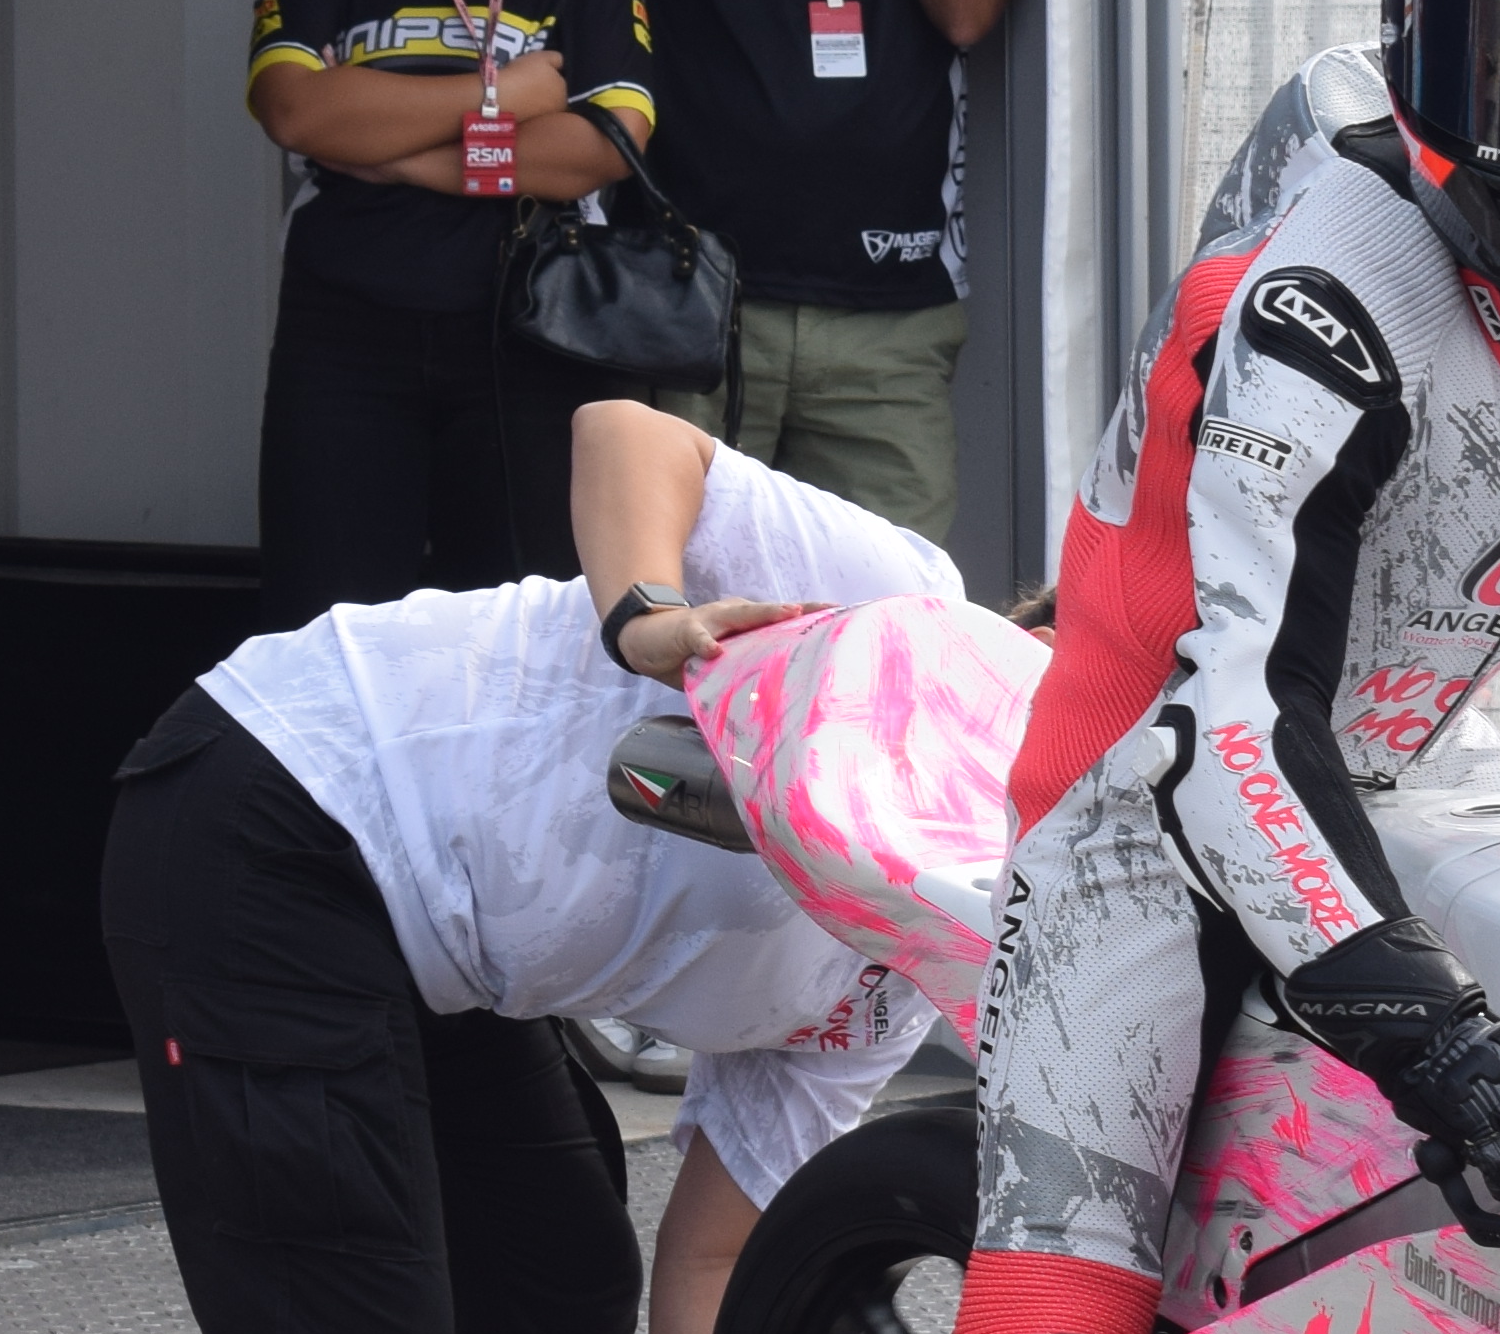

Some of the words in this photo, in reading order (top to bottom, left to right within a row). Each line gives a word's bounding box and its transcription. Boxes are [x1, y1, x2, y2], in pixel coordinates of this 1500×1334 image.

[467, 147, 512, 163] RSM
[1199, 419, 1292, 471] PIRELLI
[1354, 661, 1437, 703] NO
[1211, 723, 1269, 770] NO
[1340, 709, 1435, 752] MO
[1239, 772, 1303, 850] ONE
[1270, 843, 1359, 946] MORE
[1300, 1003, 1427, 1016] MACNA
[1405, 1242, 1446, 1302] Giulia
